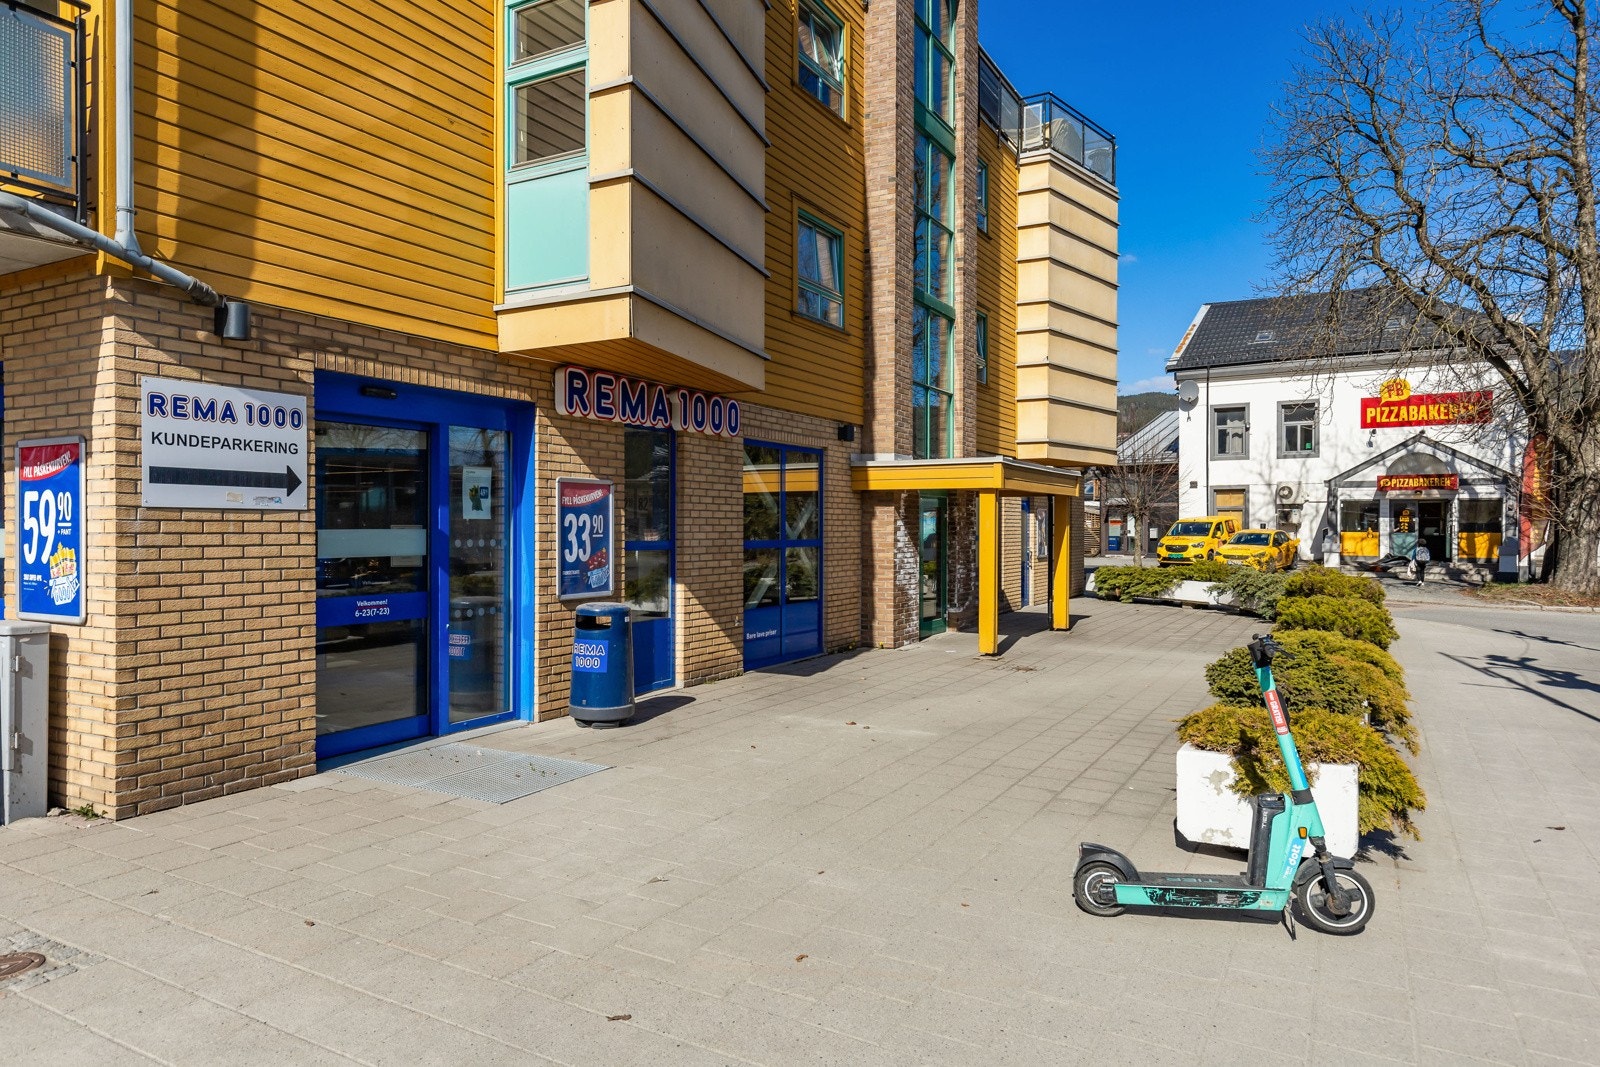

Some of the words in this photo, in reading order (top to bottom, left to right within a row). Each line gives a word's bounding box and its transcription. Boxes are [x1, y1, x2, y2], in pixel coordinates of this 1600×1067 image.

[147, 391, 239, 425] REMA
[244, 402, 304, 431] 1000
[563, 366, 670, 428] REMA
[678, 388, 741, 437] 1000
[151, 431, 299, 455] KUNDEPARKERING
[1391, 477, 1451, 488] PIZZABAKEREN
[23, 489, 56, 565] 59
[57, 491, 72, 521] 90
[564, 513, 592, 563] 33
[592, 514, 604, 534] 90
[355, 607, 390, 617] 6-23(7-23)
[356, 598, 388, 607] Velkommen!
[574, 643, 605, 656] REMA
[575, 656, 600, 669] 1000
[1288, 844, 1302, 866] dott
